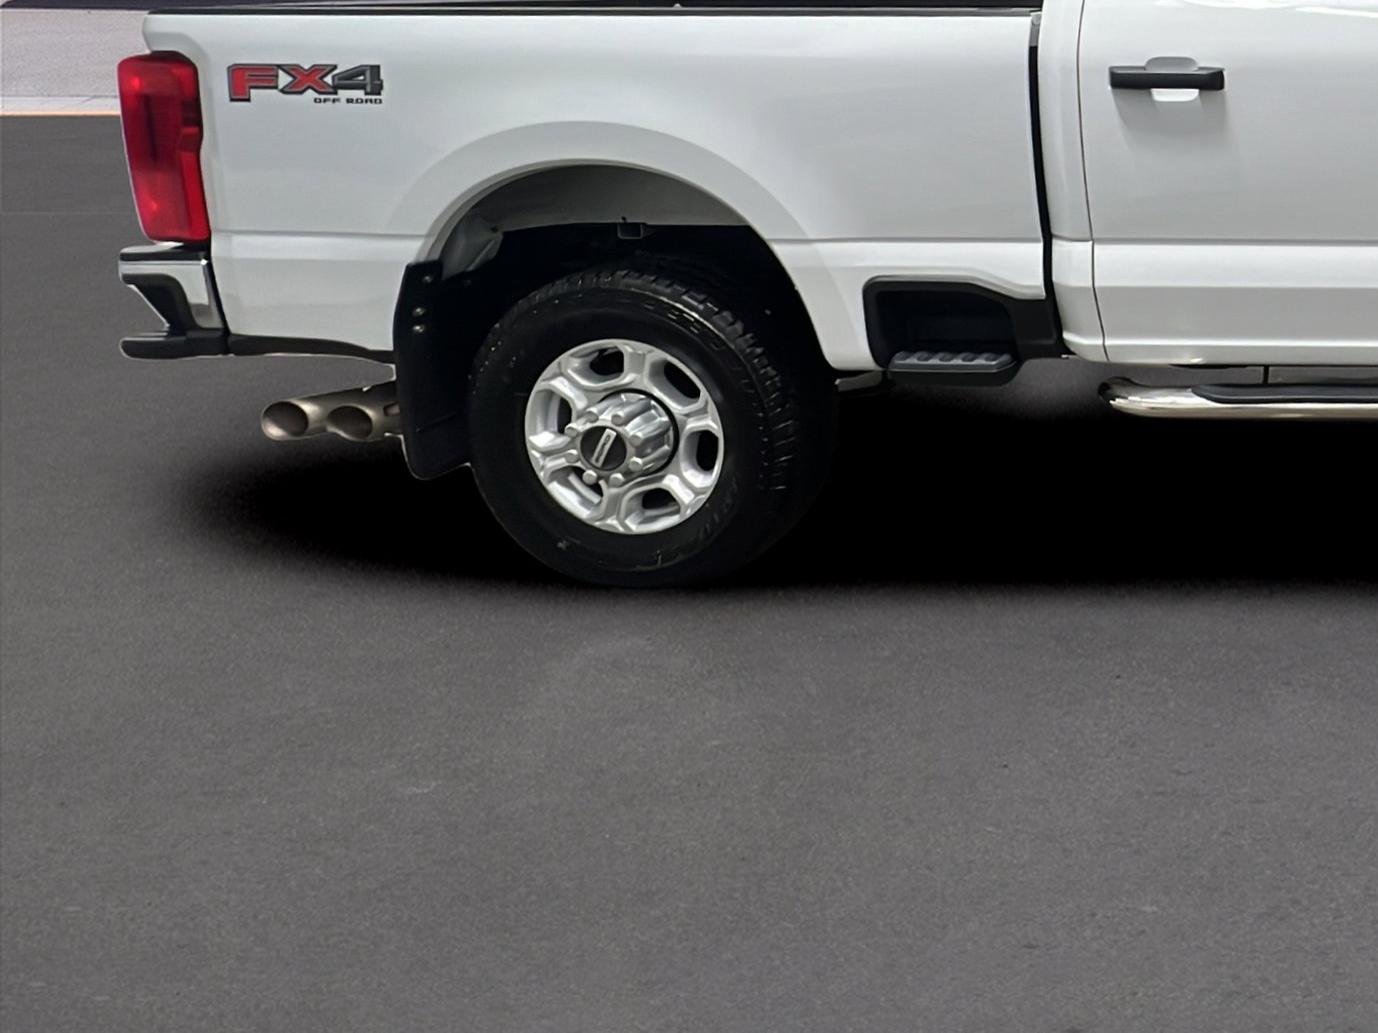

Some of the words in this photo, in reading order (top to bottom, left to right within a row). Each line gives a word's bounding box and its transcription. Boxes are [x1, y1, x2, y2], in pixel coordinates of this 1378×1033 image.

[227, 63, 383, 102] FX4
[313, 97, 341, 105] OFF
[345, 97, 382, 105] ROAD
